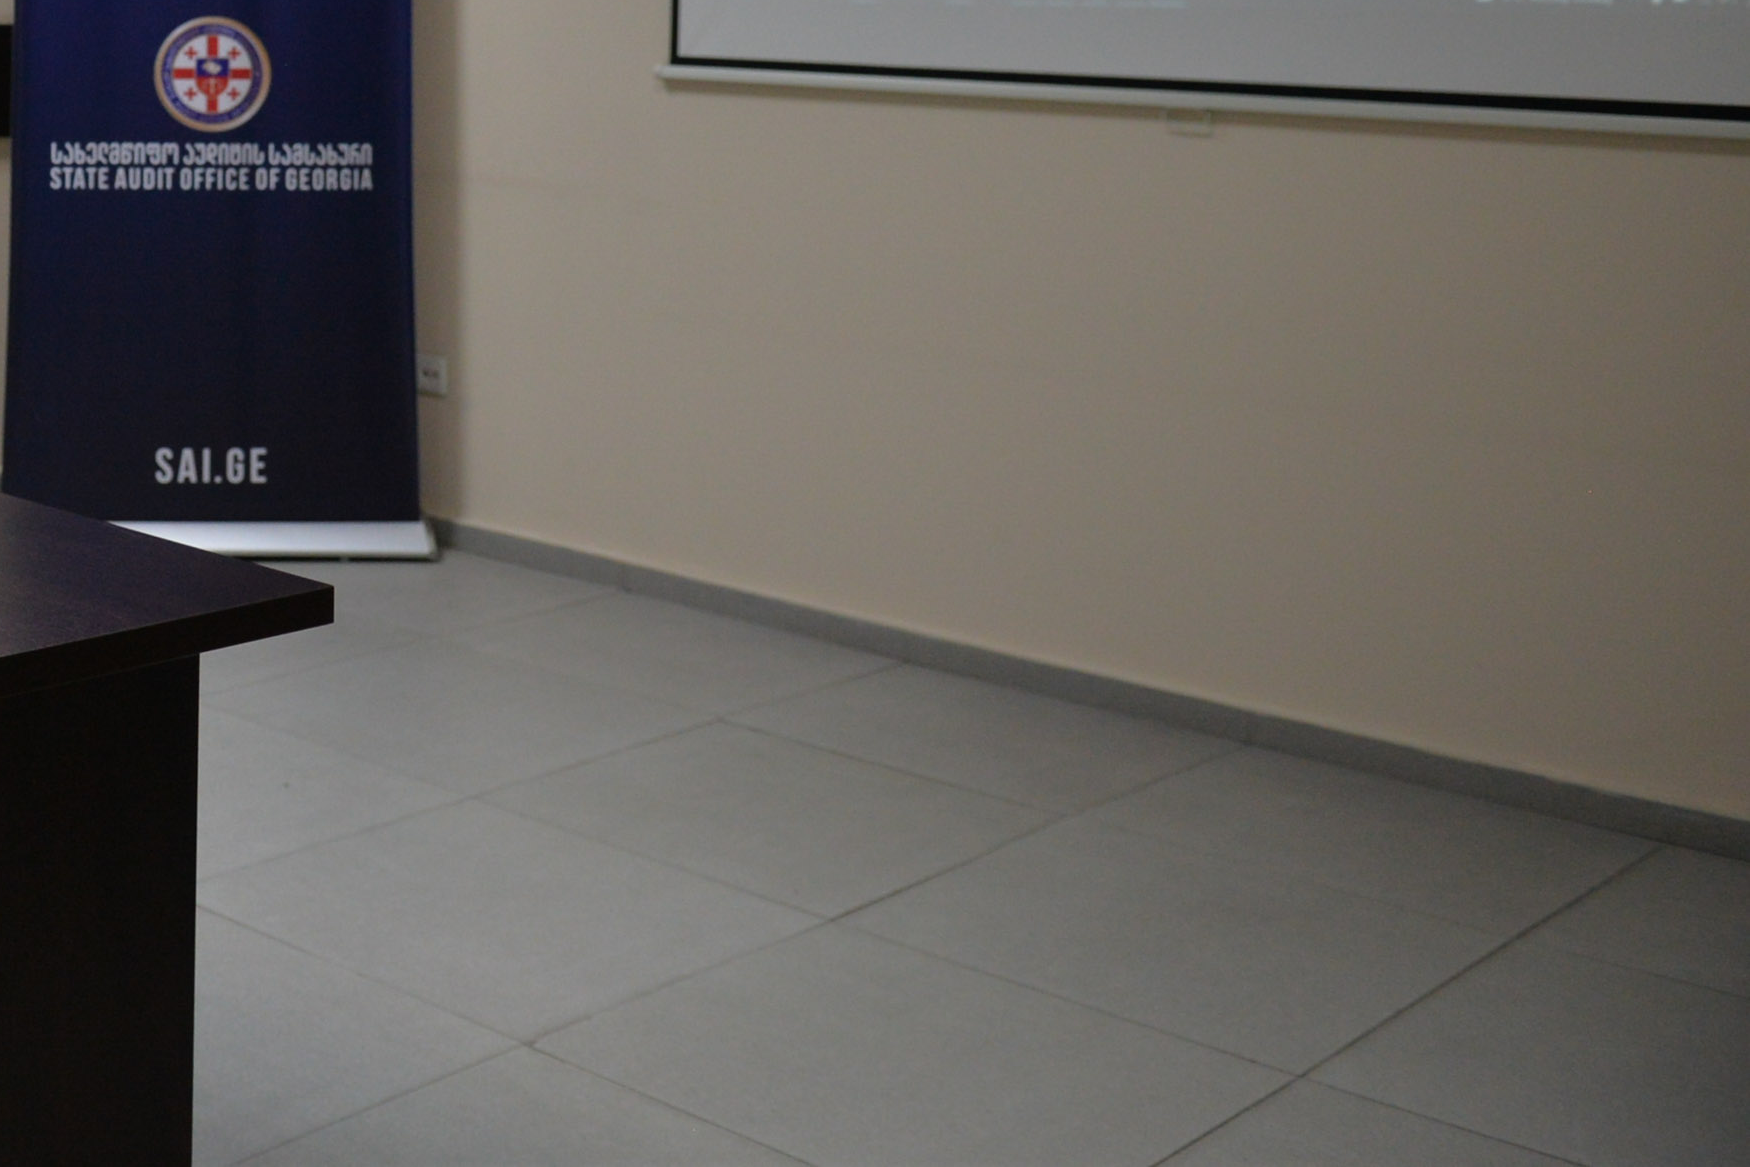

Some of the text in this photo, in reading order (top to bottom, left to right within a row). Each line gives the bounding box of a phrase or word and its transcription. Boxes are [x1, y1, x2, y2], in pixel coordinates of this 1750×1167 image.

[49, 167, 373, 191] STATE AUDIT OFFICE OF GEORGIA
[155, 447, 268, 484] SAI.GE
